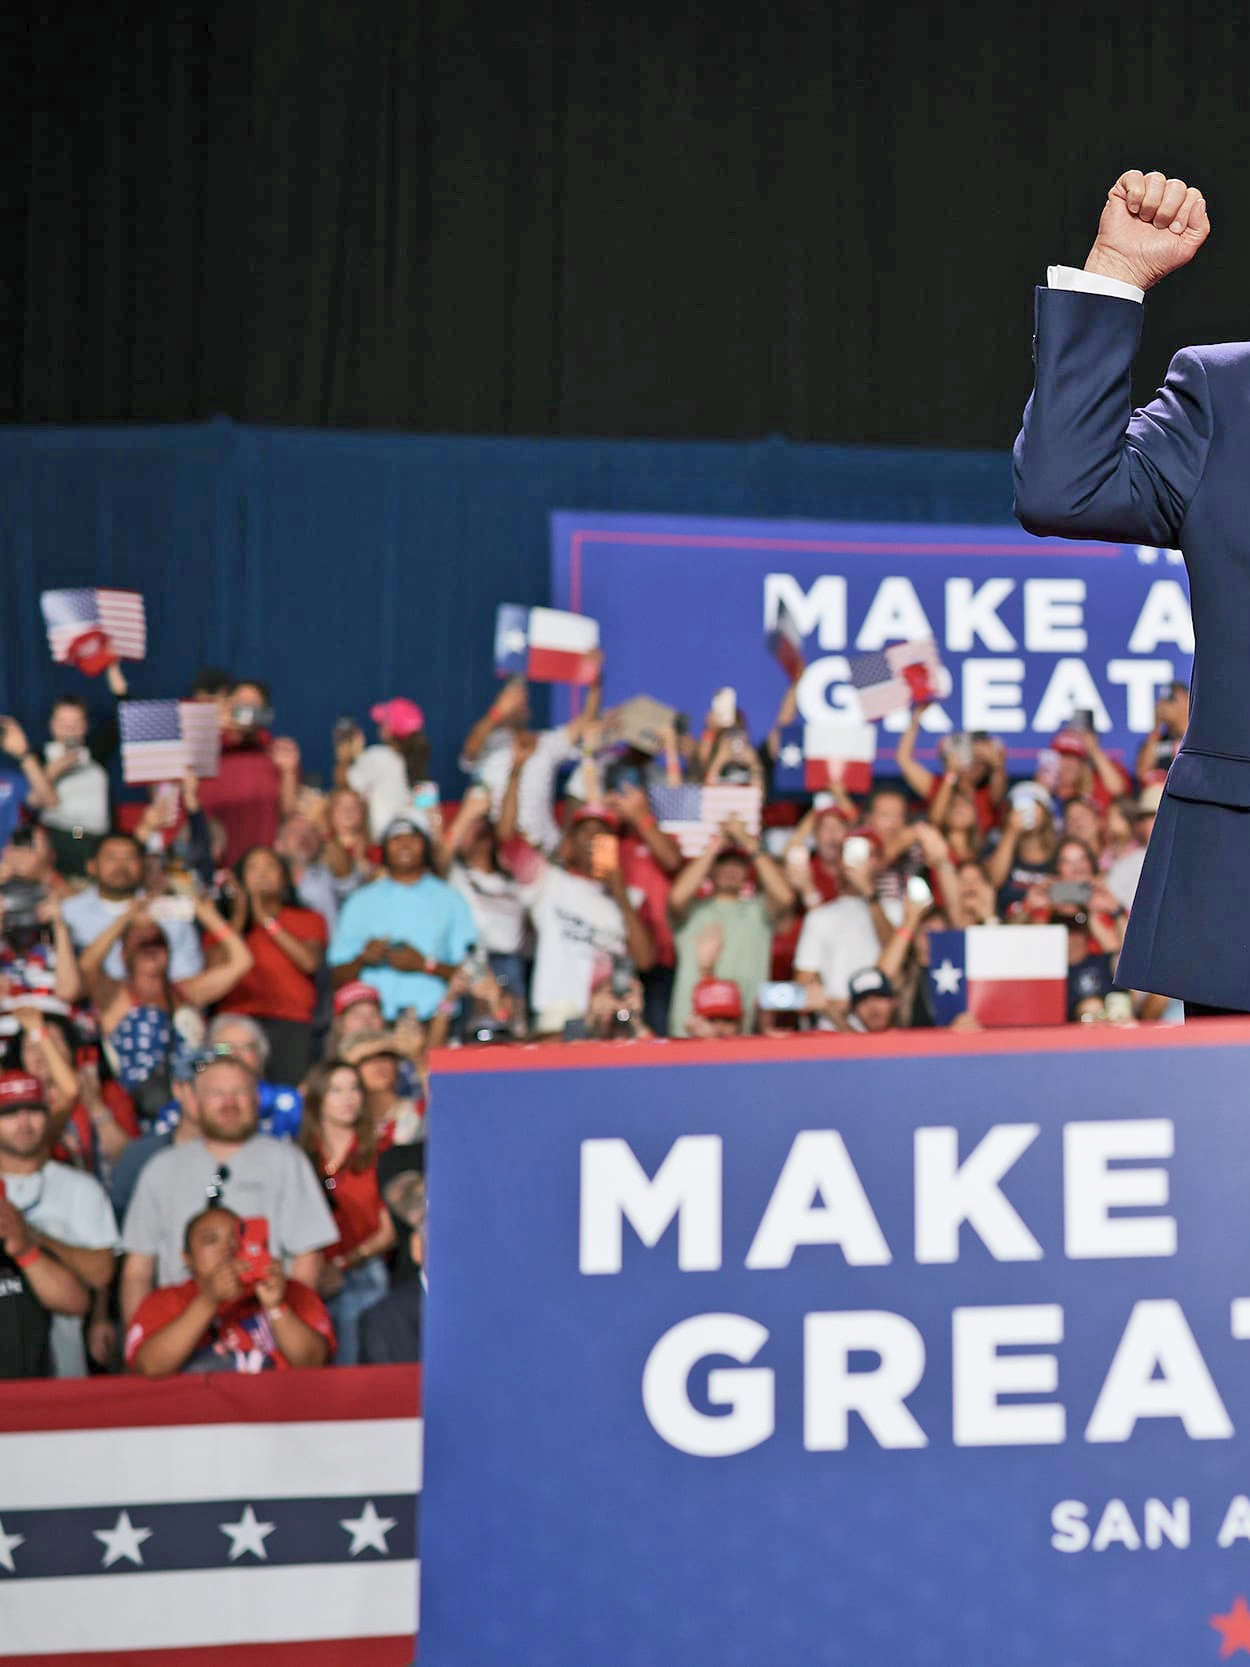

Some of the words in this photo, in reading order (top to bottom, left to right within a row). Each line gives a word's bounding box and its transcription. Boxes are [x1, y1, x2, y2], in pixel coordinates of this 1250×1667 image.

[764, 573, 1088, 653] MAKE
[580, 1119, 1178, 1275] MAKE
[1050, 1497, 1191, 1553] SAN
